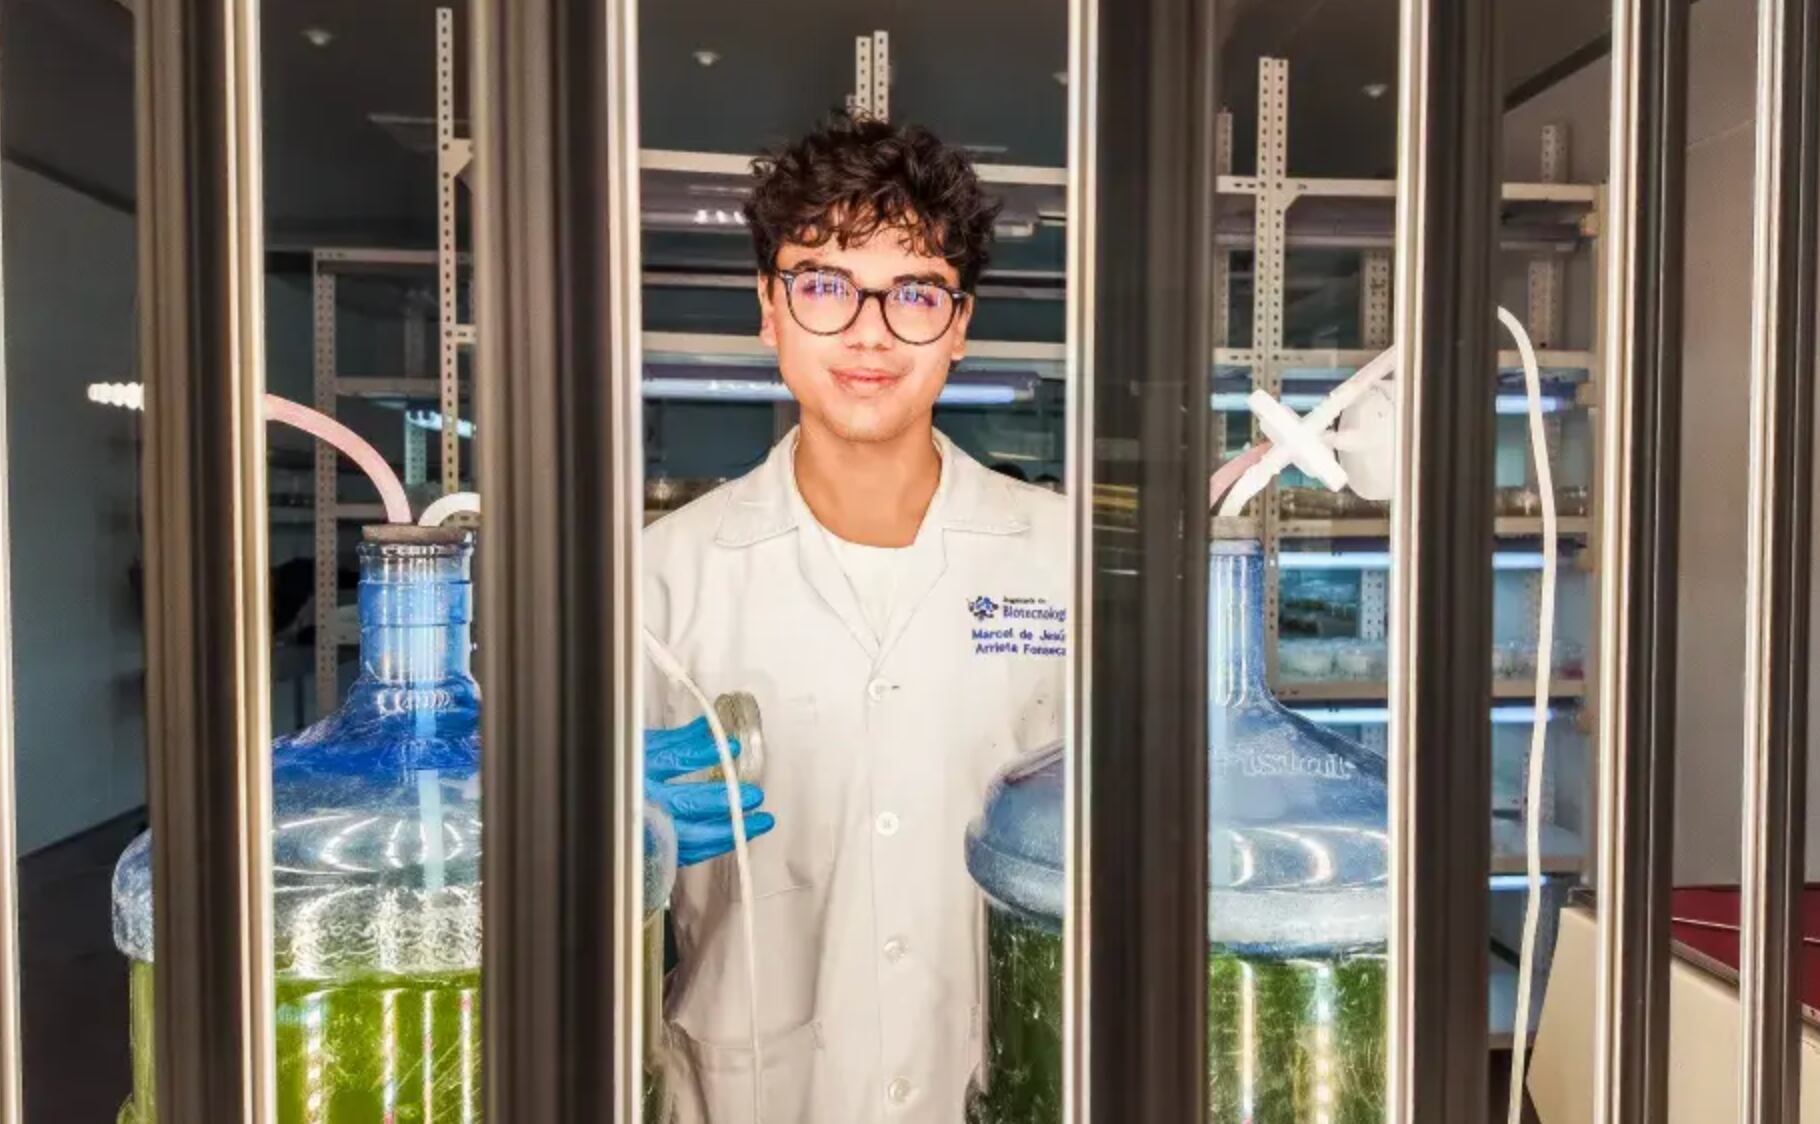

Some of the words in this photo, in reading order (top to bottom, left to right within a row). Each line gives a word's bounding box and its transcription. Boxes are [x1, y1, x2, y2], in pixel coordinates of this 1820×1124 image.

[1003, 605, 1067, 622] Biotecnolog
[972, 627, 1013, 641] Marcel
[1019, 628, 1033, 641] de
[1039, 628, 1065, 641] Jesú
[975, 642, 1018, 655] Arrieta
